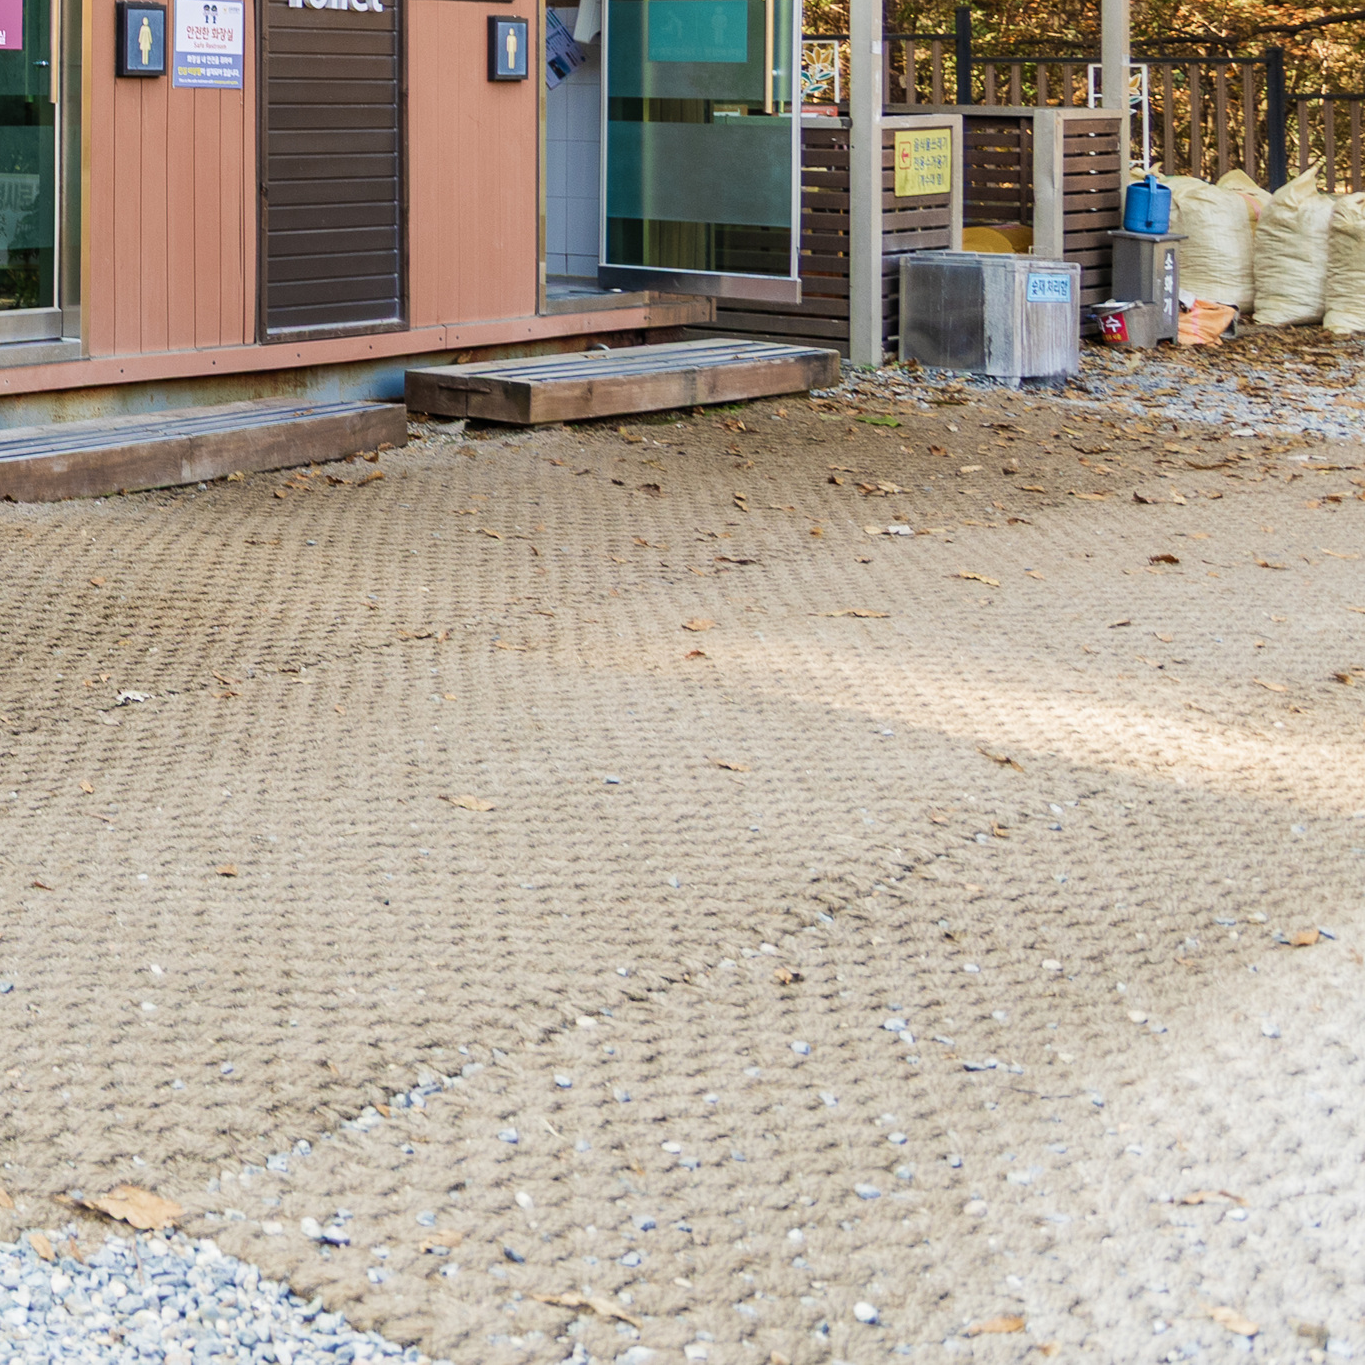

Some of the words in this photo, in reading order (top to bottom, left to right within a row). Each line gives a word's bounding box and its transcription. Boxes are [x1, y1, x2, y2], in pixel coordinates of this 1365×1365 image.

[186, 25, 209, 40] 안전한
[212, 27, 233, 42] 화장실
[914, 136, 948, 153] 음식물쓰레기
[914, 154, 948, 171] 전용수거용기
[1047, 280, 1068, 296] 처리함
[1163, 252, 1174, 316] 소화기
